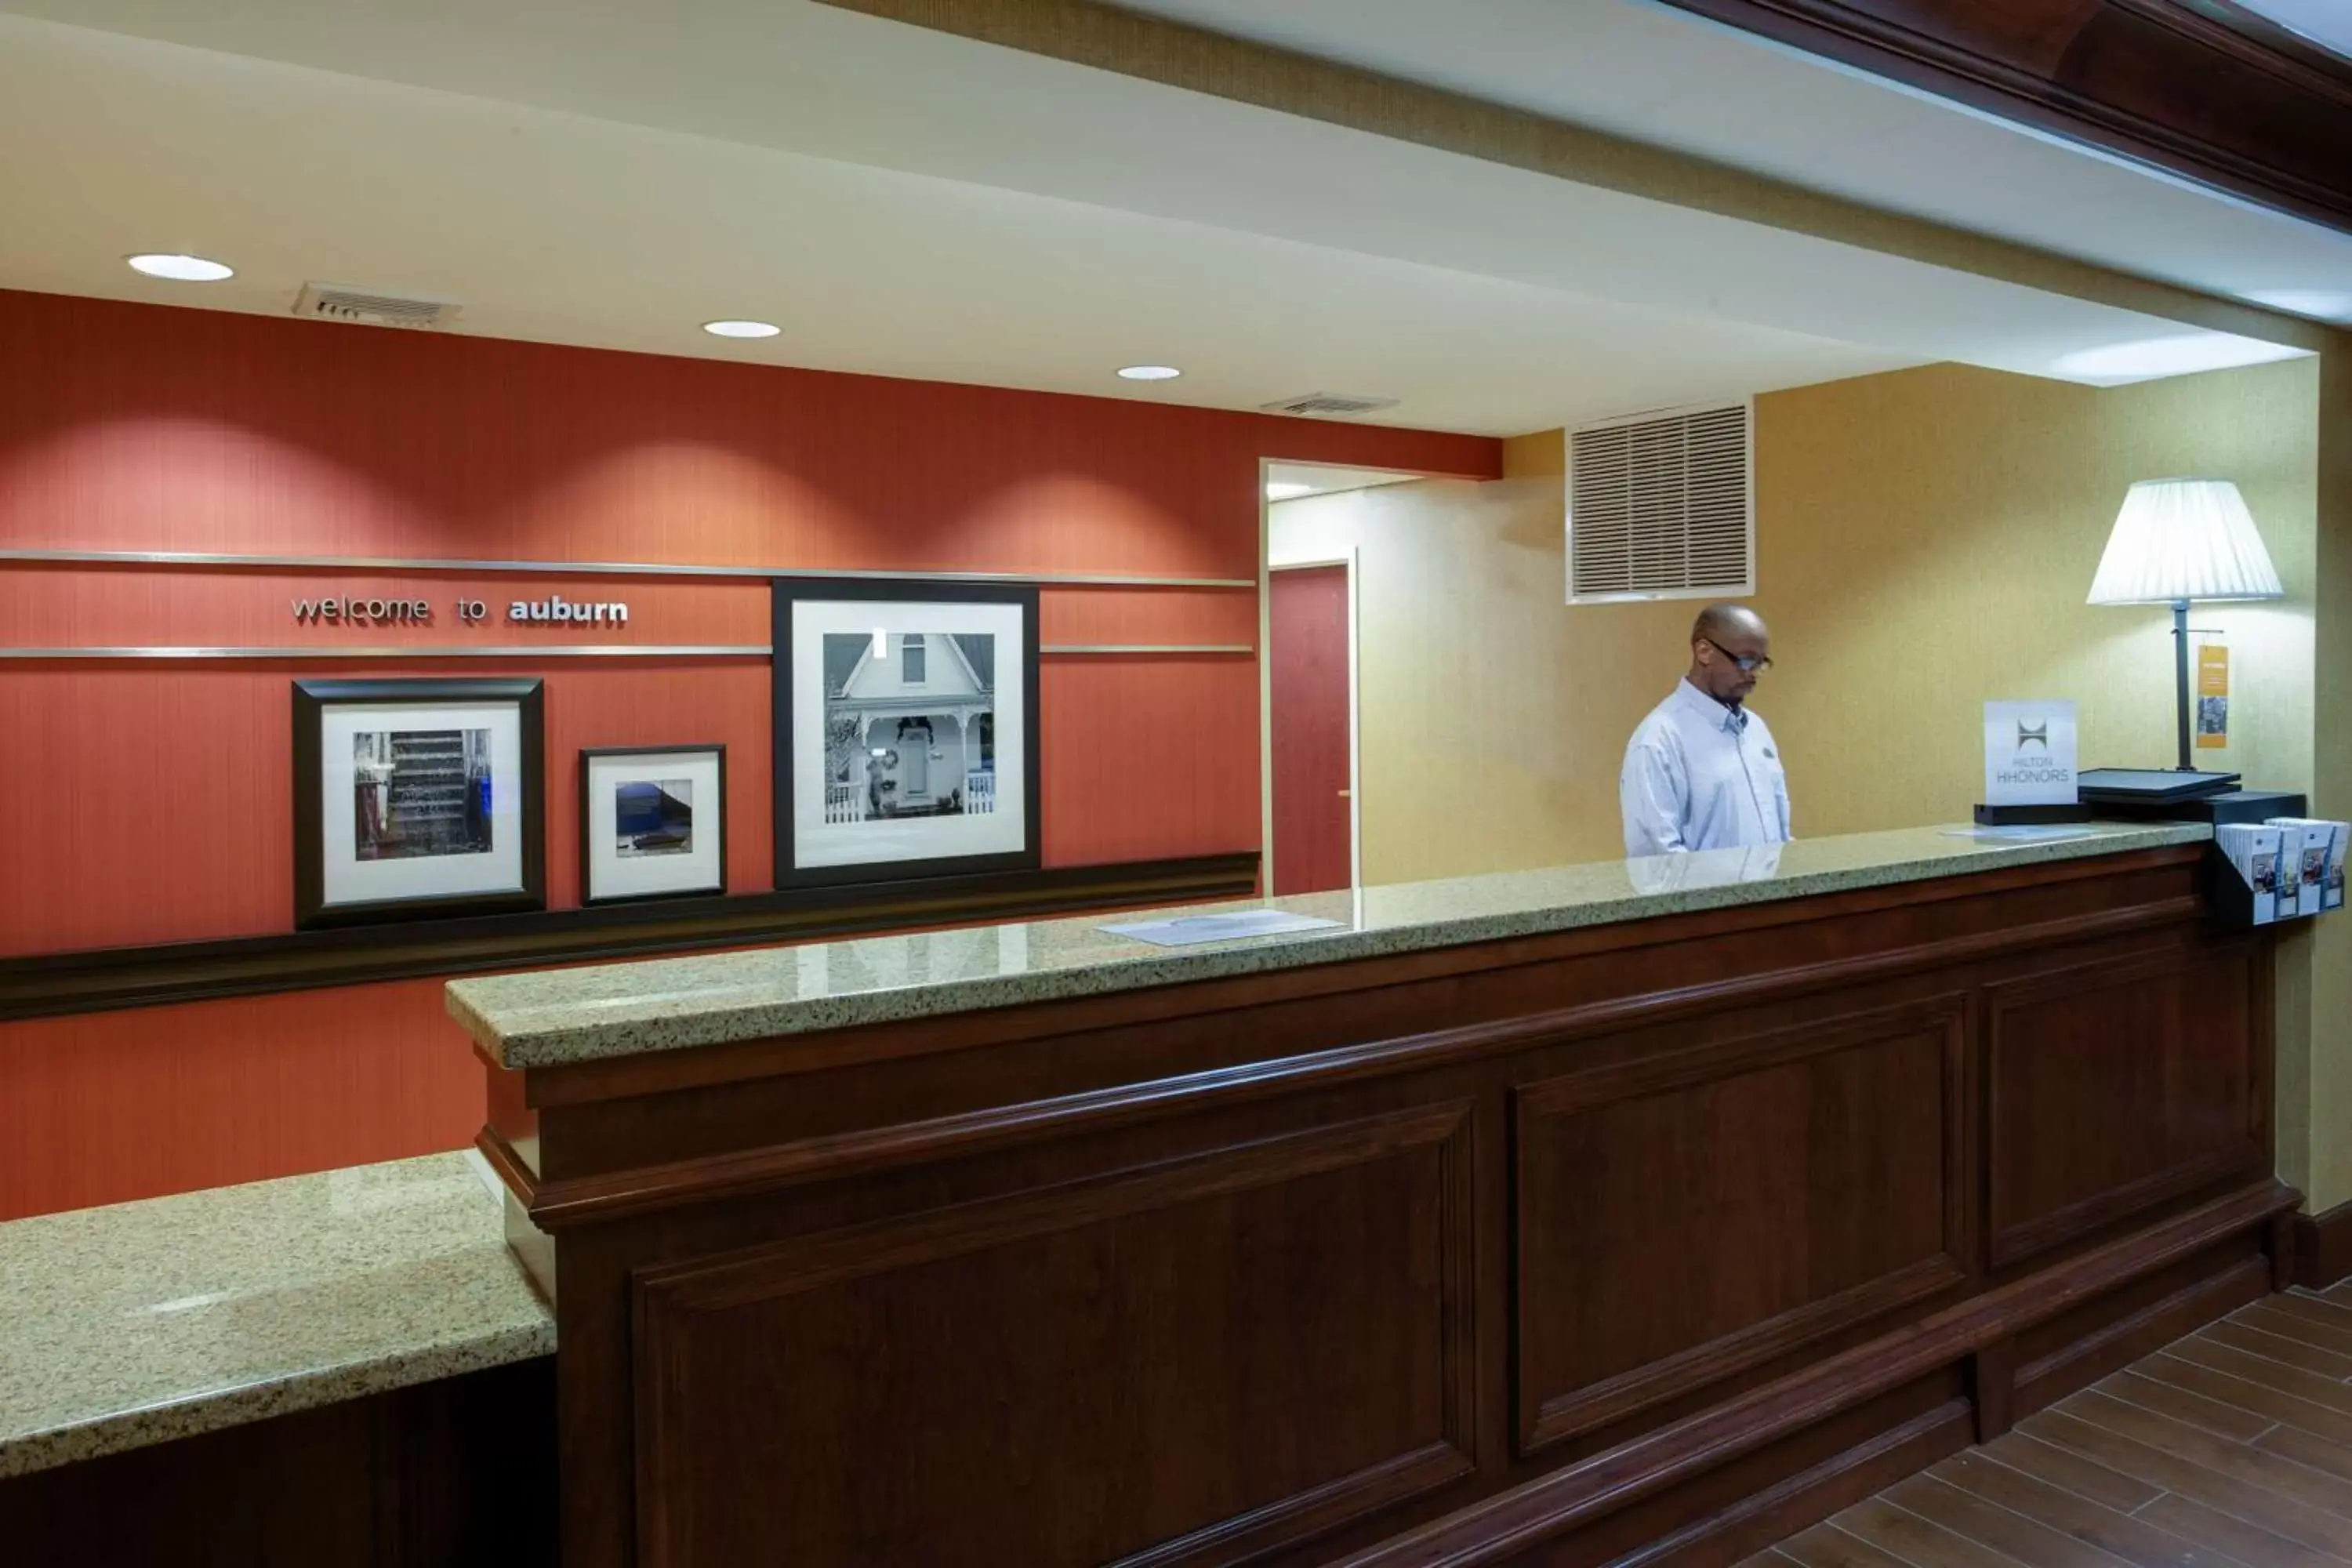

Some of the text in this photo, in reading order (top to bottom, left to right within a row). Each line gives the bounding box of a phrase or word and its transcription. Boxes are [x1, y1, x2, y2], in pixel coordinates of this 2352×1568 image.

[291, 593, 628, 622] welcome to auburn
[1997, 769, 2070, 783] HHONORS
